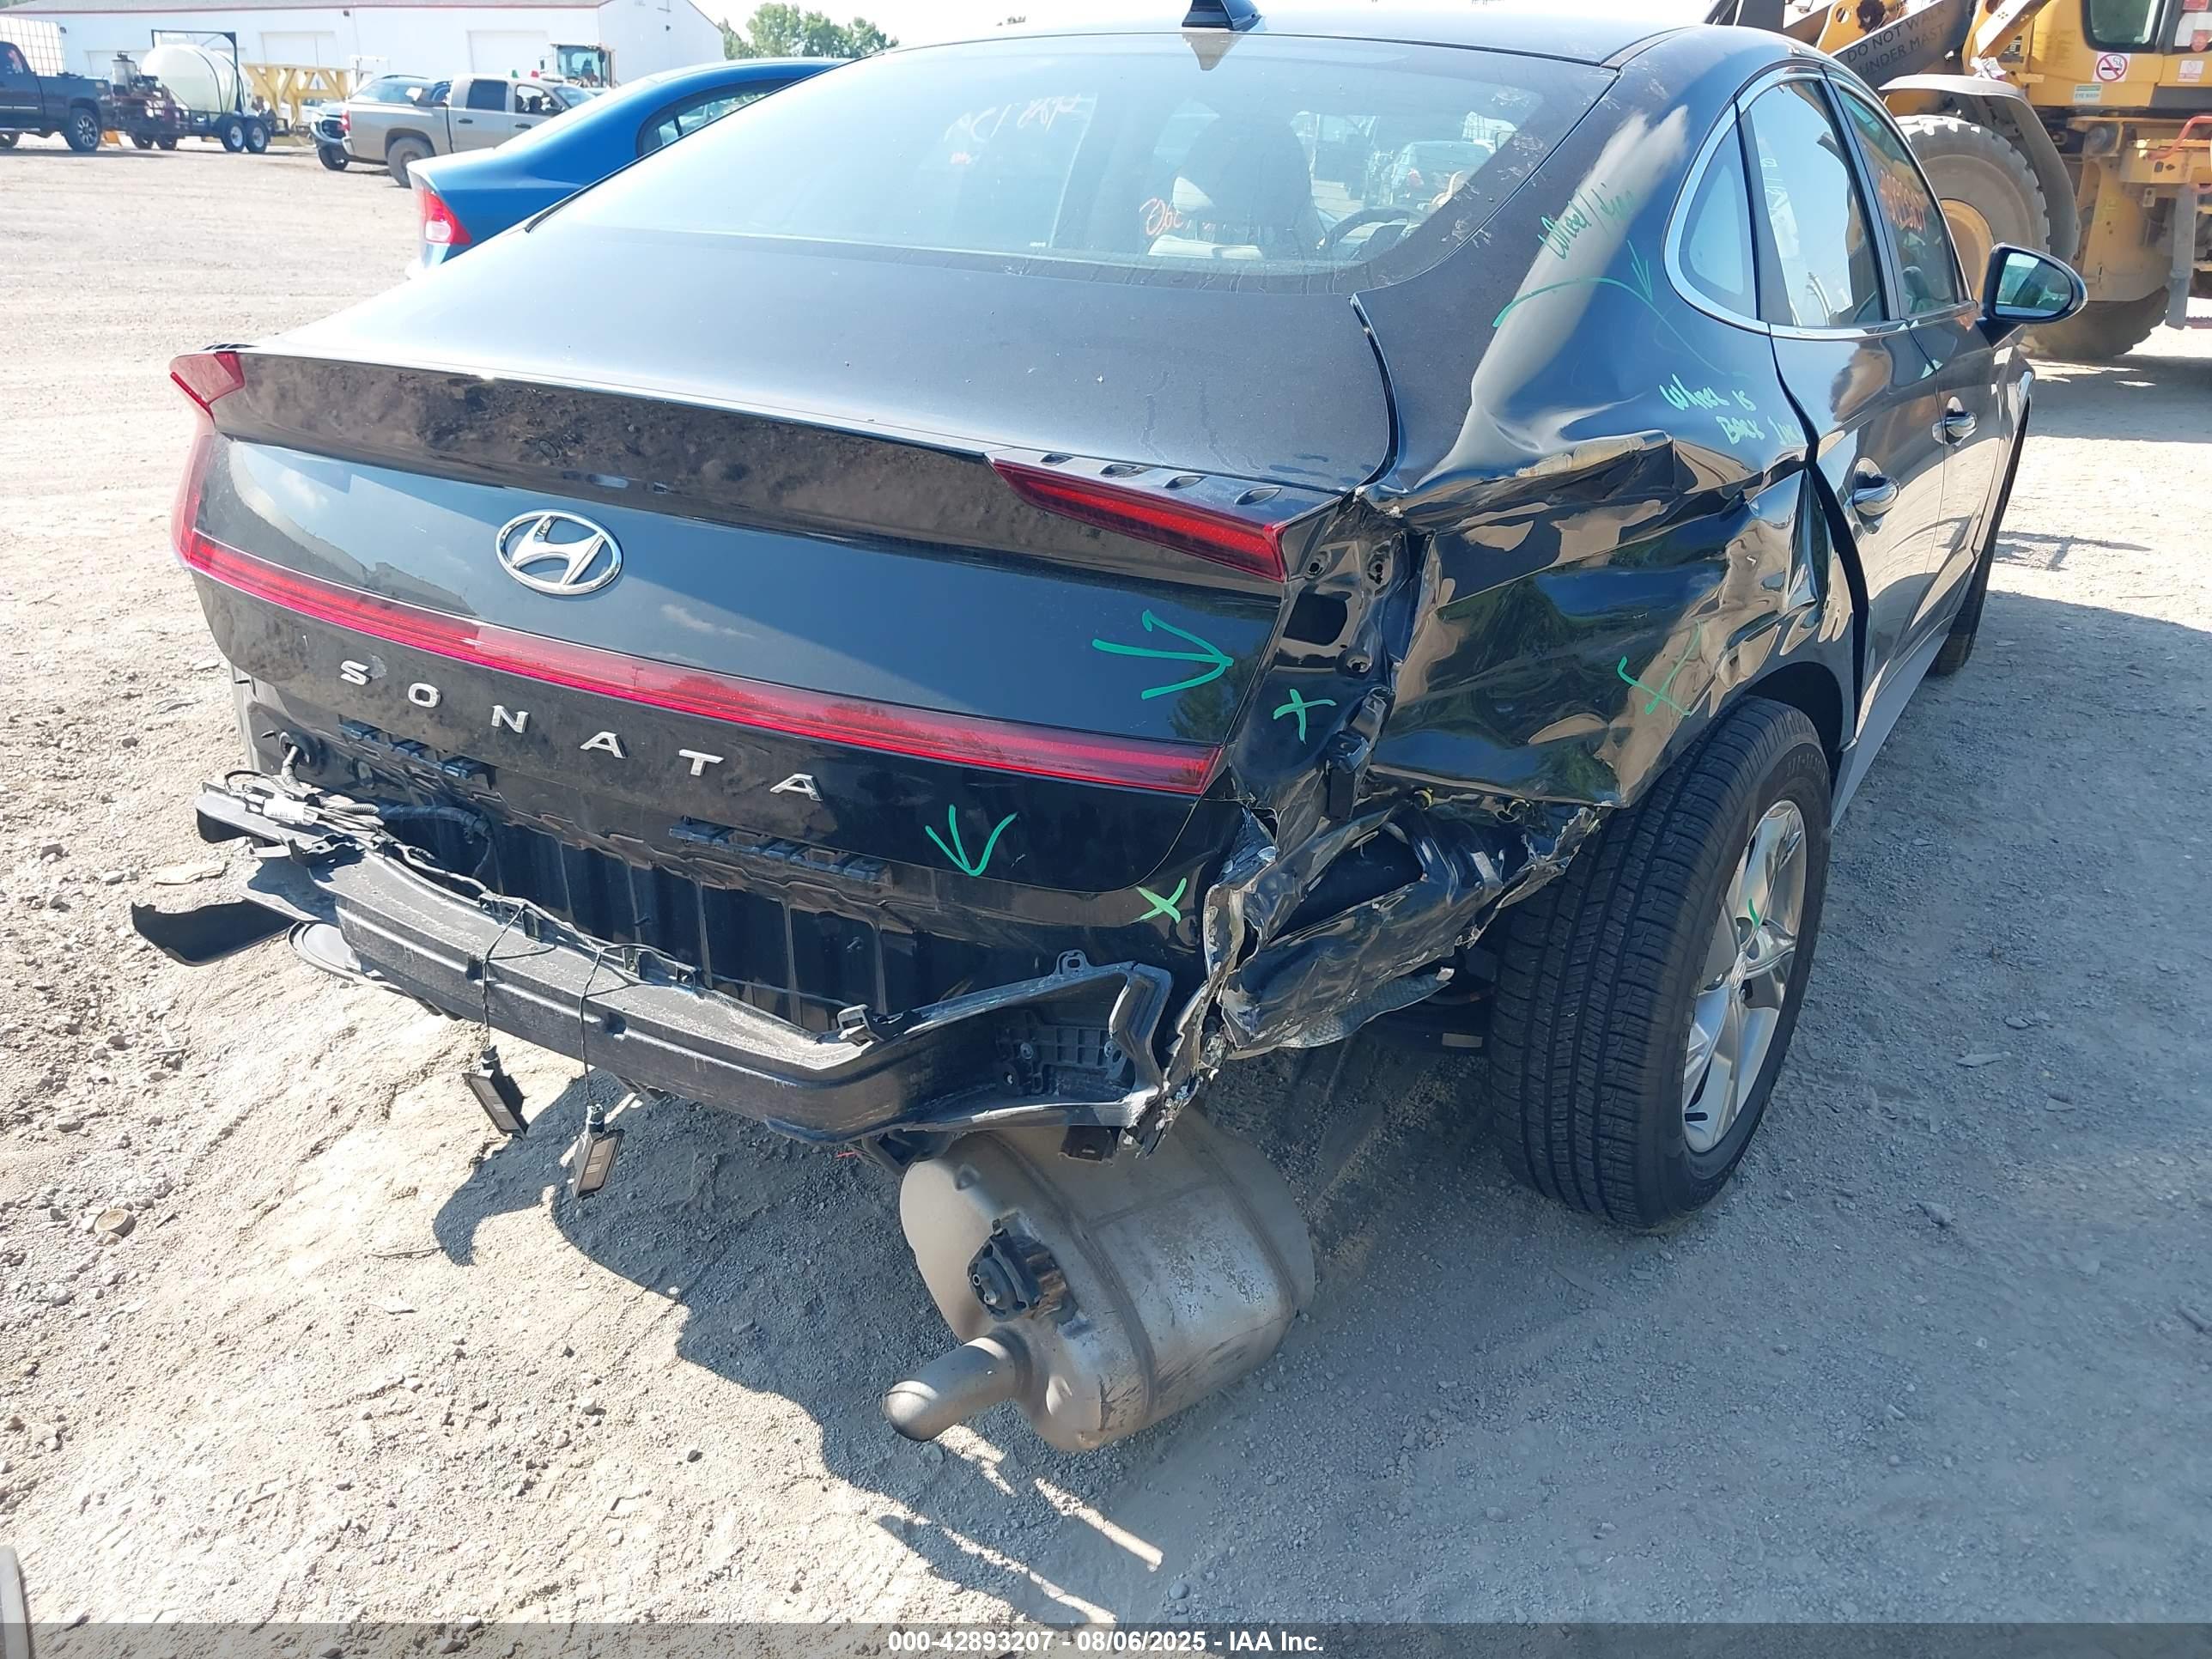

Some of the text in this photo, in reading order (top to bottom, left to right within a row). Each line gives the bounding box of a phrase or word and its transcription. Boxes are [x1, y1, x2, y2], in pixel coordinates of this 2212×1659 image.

[1846, 43, 1869, 64] DO
[1871, 26, 1904, 50] NOT
[1858, 22, 1946, 76] UNDER MAST
[340, 659, 824, 802] SONATA
